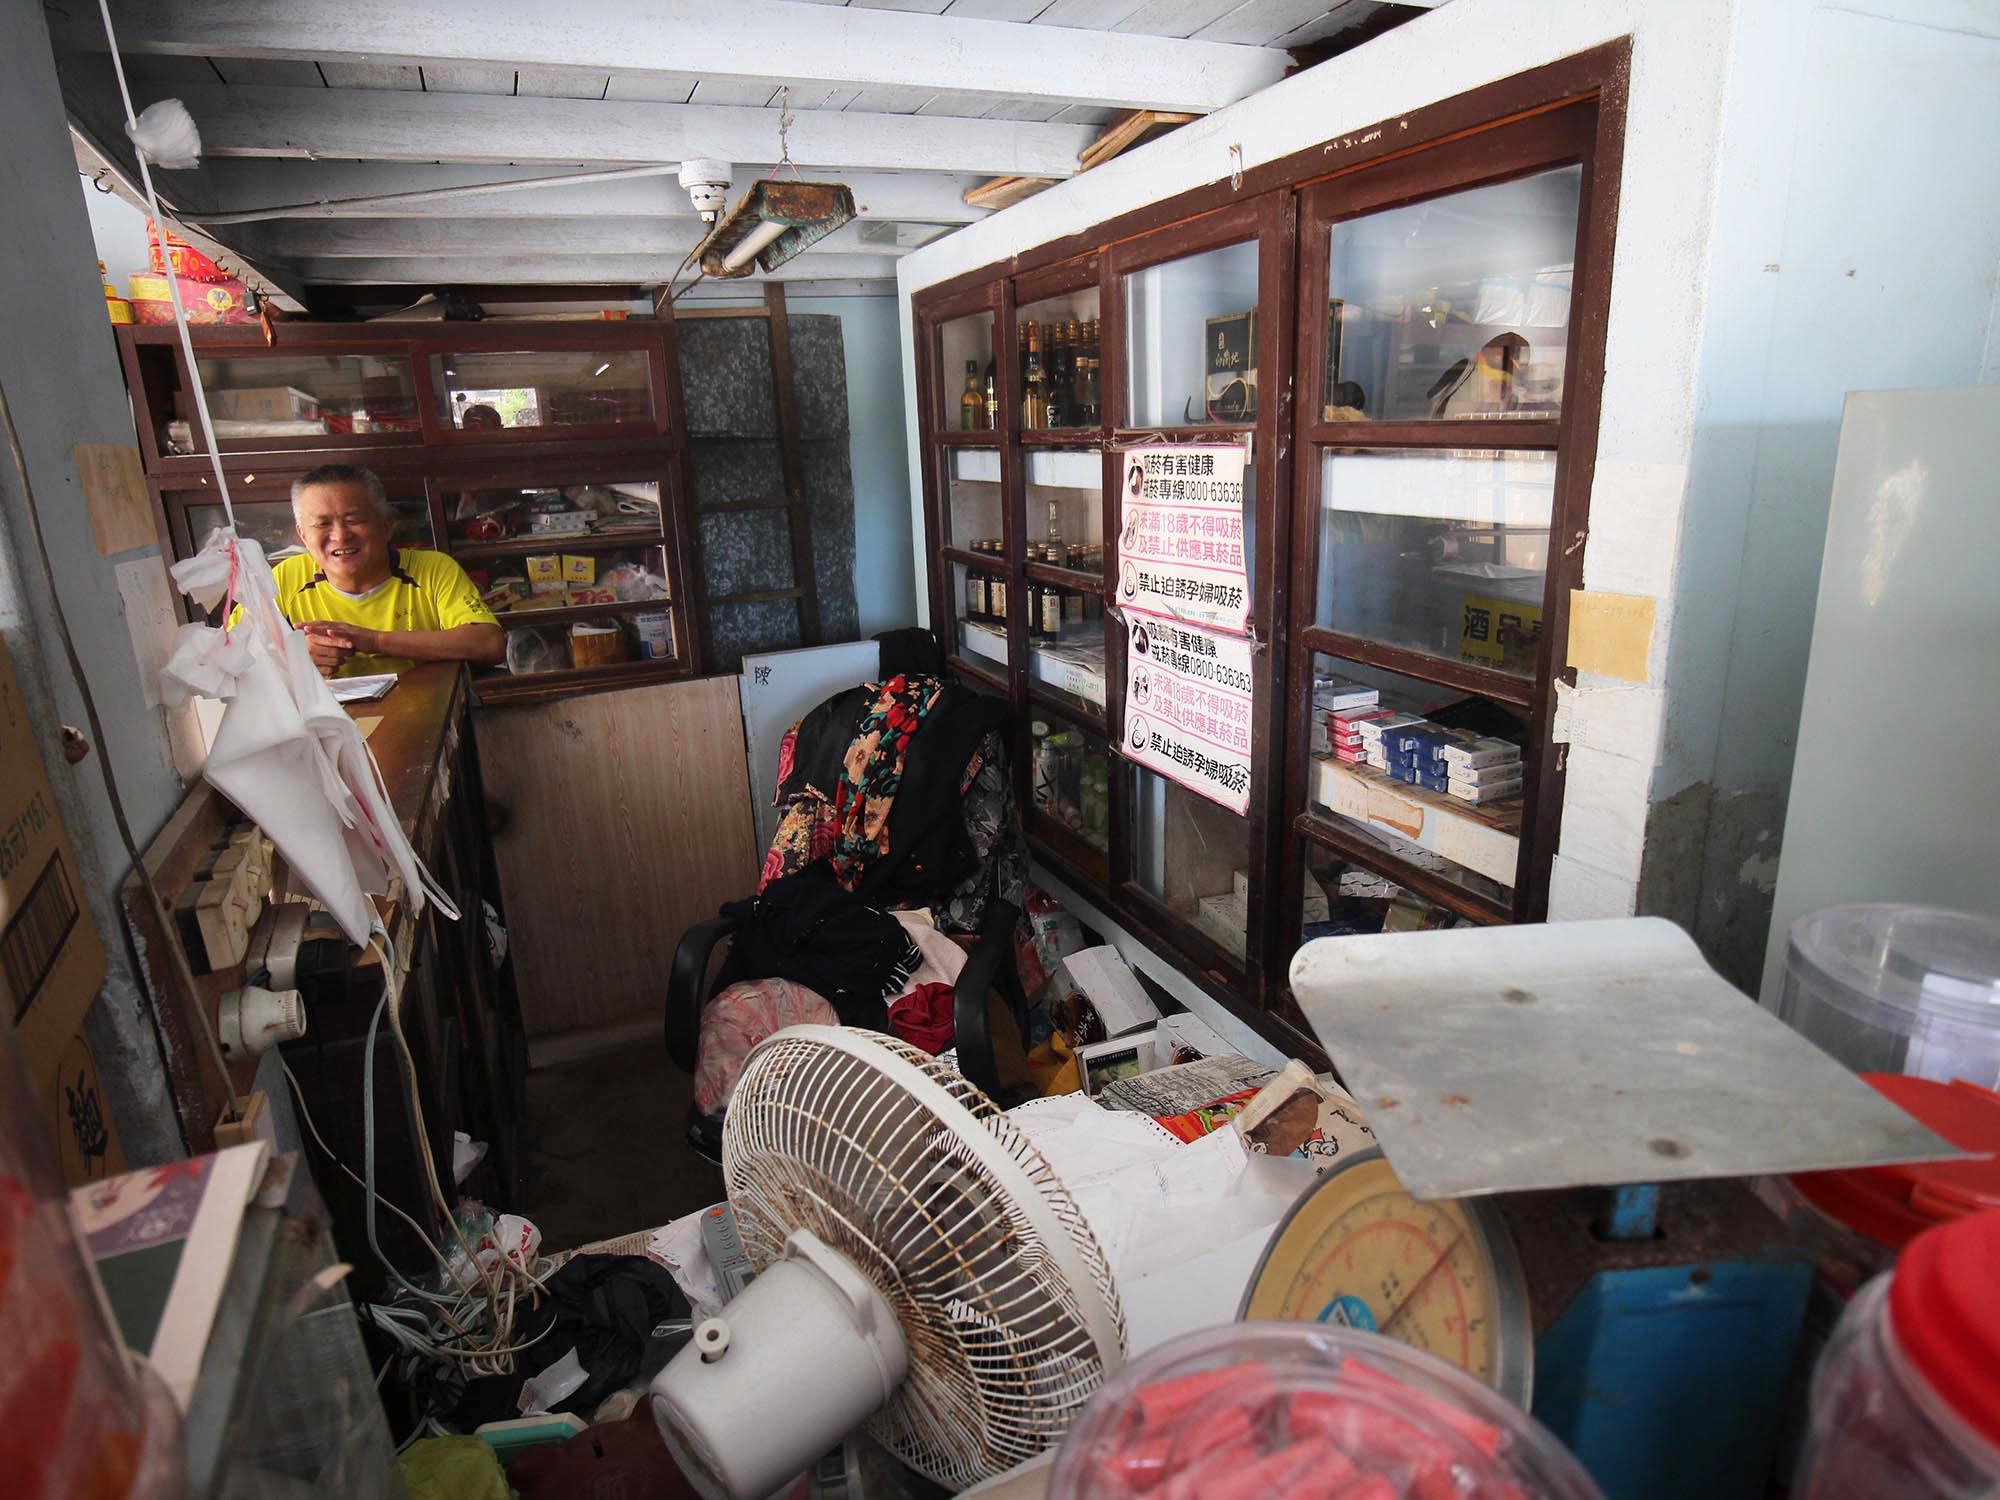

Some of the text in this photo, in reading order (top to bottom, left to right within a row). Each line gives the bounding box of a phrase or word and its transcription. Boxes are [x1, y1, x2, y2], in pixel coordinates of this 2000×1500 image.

[1140, 511, 1242, 541] 未滿18歲不得吸菸
[1138, 534, 1242, 567] 及禁止供應其菸品
[1139, 572, 1243, 609] 禁止迫誘孕婦吸菸
[1154, 671, 1248, 725] 未滿18歲不得吸菸
[1153, 694, 1248, 749] 及禁止供應其菸品
[1150, 731, 1248, 794] 禁止迫誘孕婦吸菸
